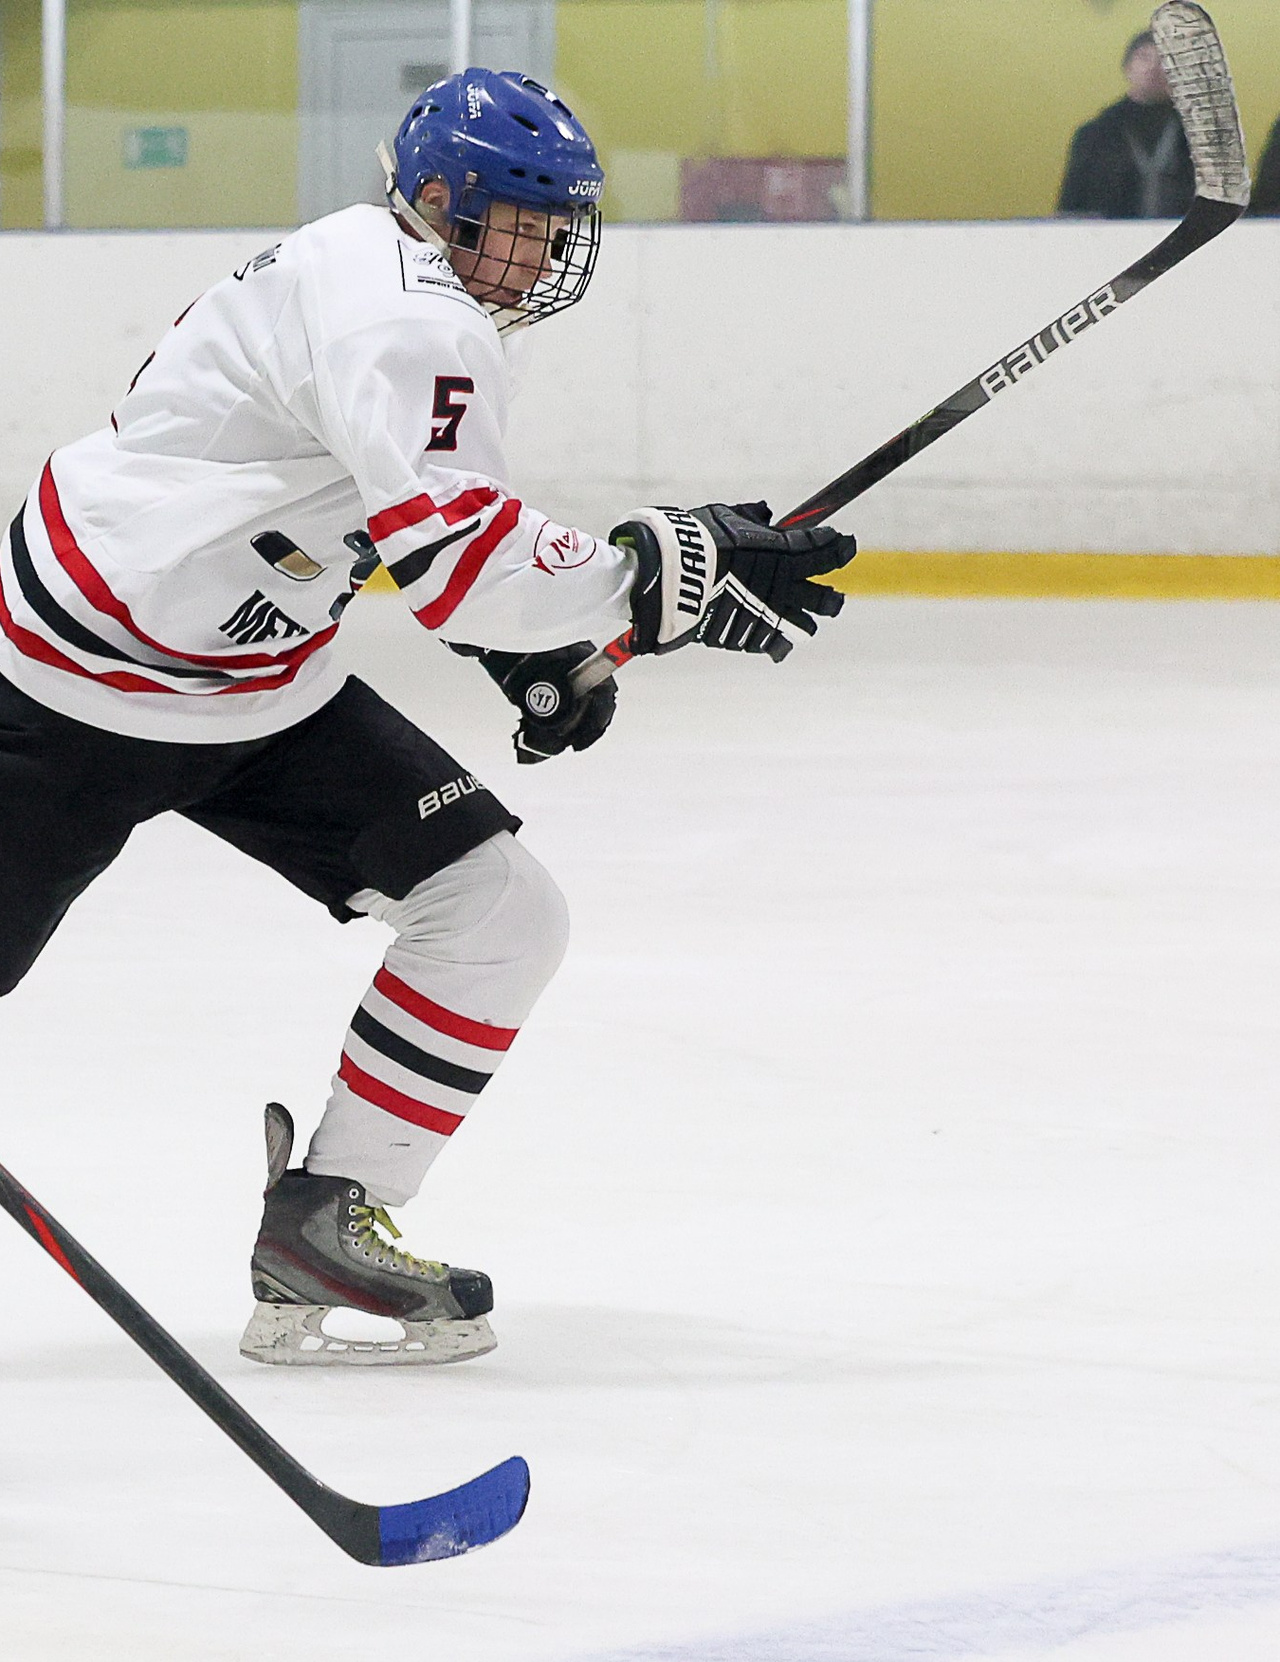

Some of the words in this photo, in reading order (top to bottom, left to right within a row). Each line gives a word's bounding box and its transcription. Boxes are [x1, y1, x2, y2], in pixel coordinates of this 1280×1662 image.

[978, 283, 1122, 401] BAUER
[424, 375, 475, 452] 5
[660, 506, 707, 617] WARR
